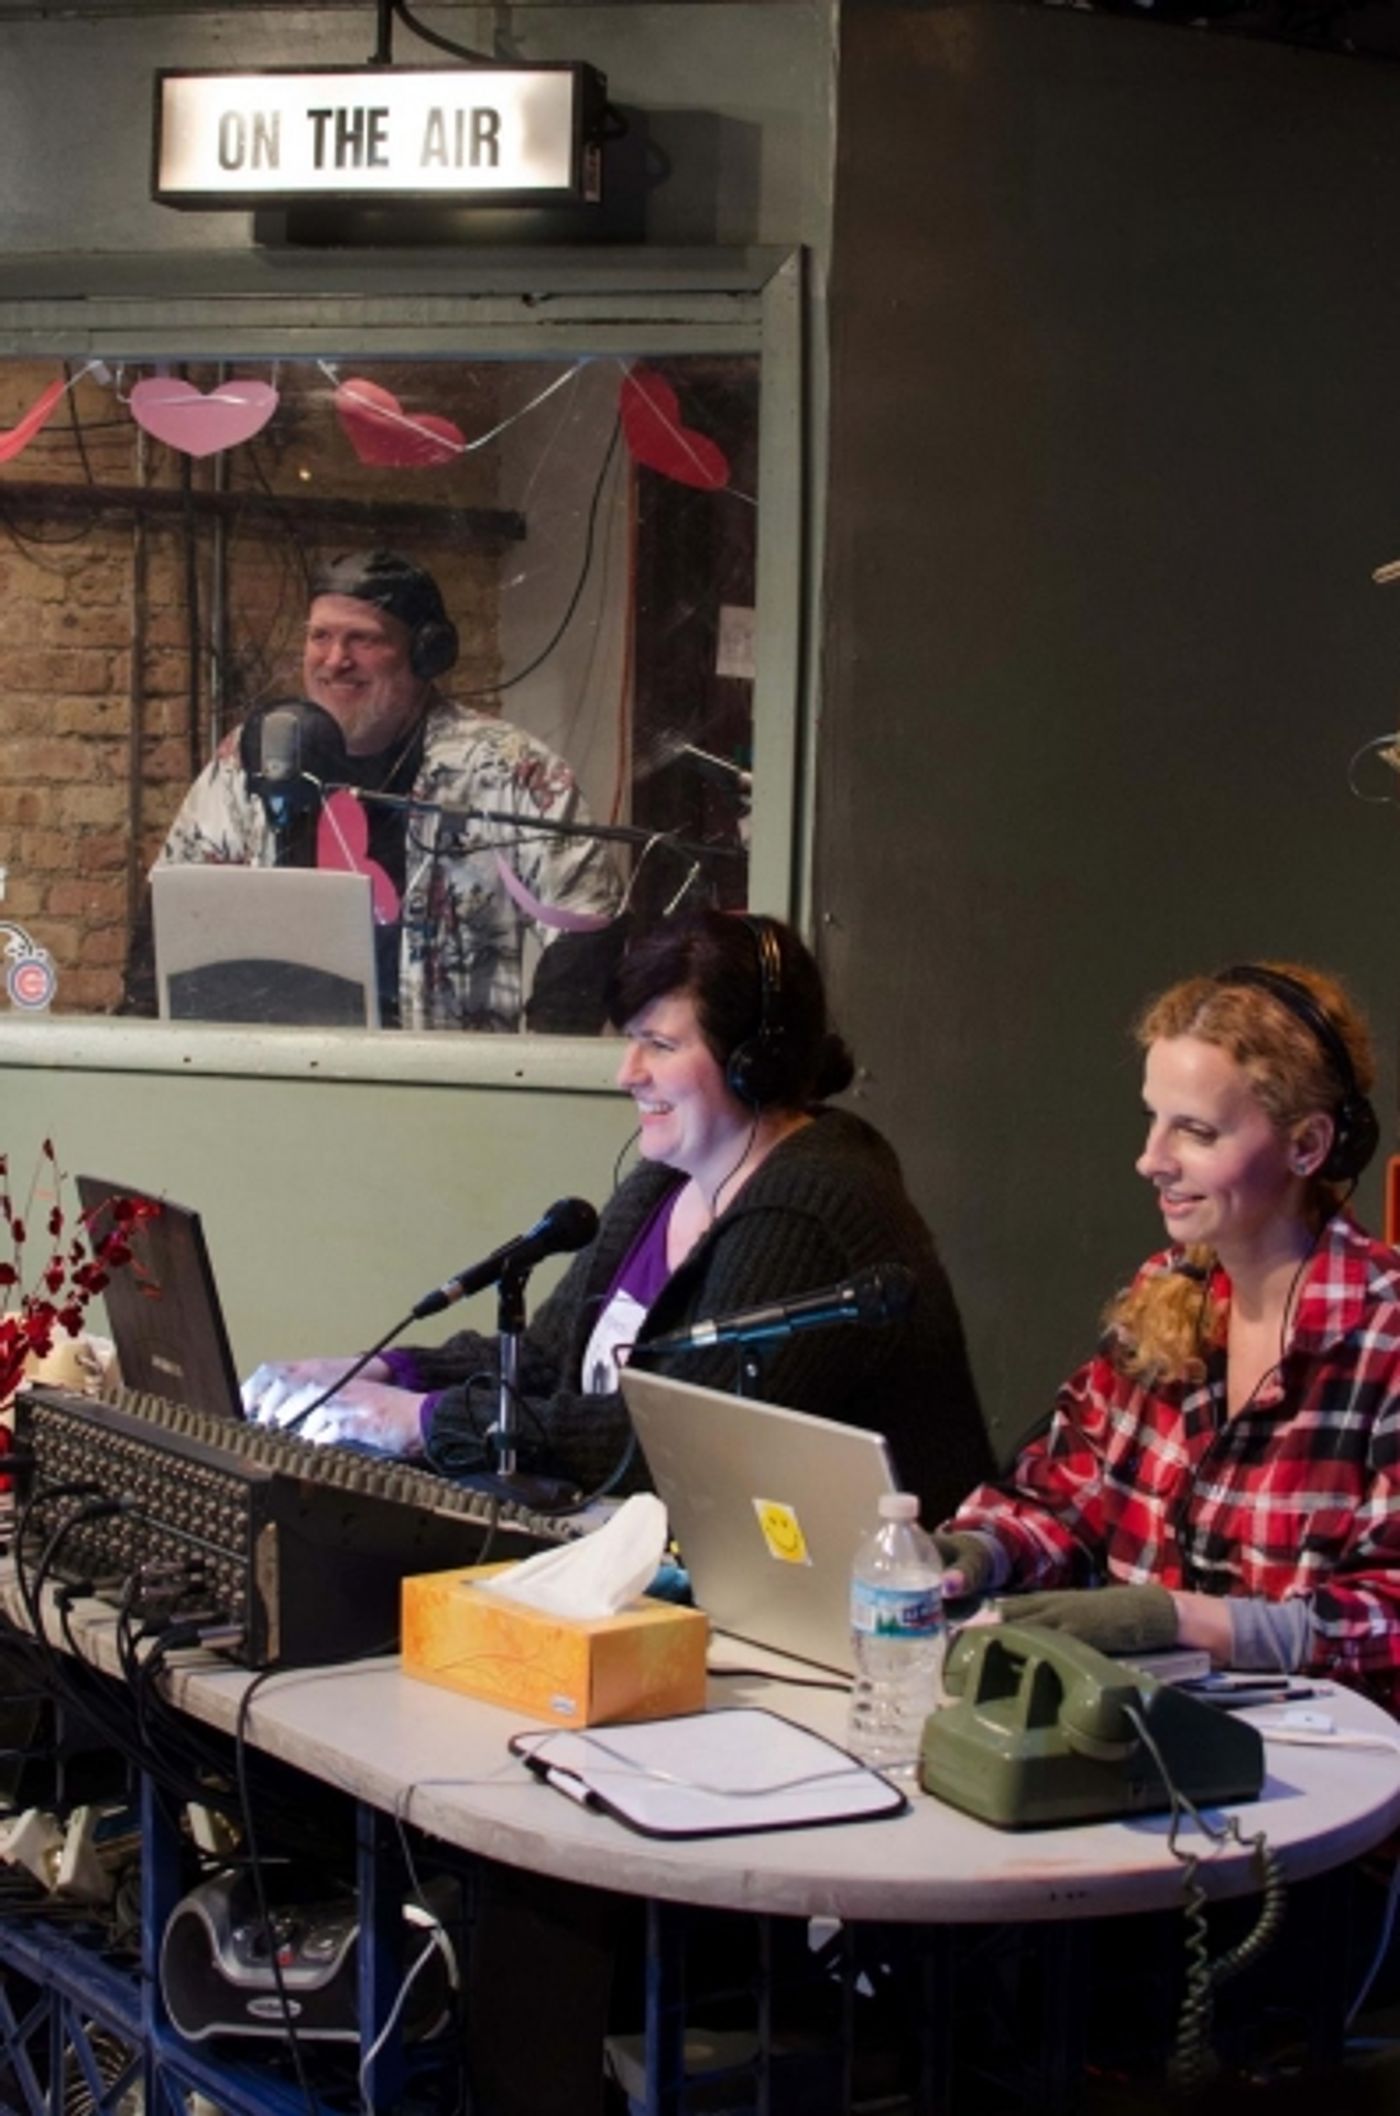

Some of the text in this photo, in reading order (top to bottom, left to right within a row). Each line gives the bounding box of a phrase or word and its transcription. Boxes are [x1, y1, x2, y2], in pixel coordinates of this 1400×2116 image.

[218, 107, 502, 170] ON THE AIR
